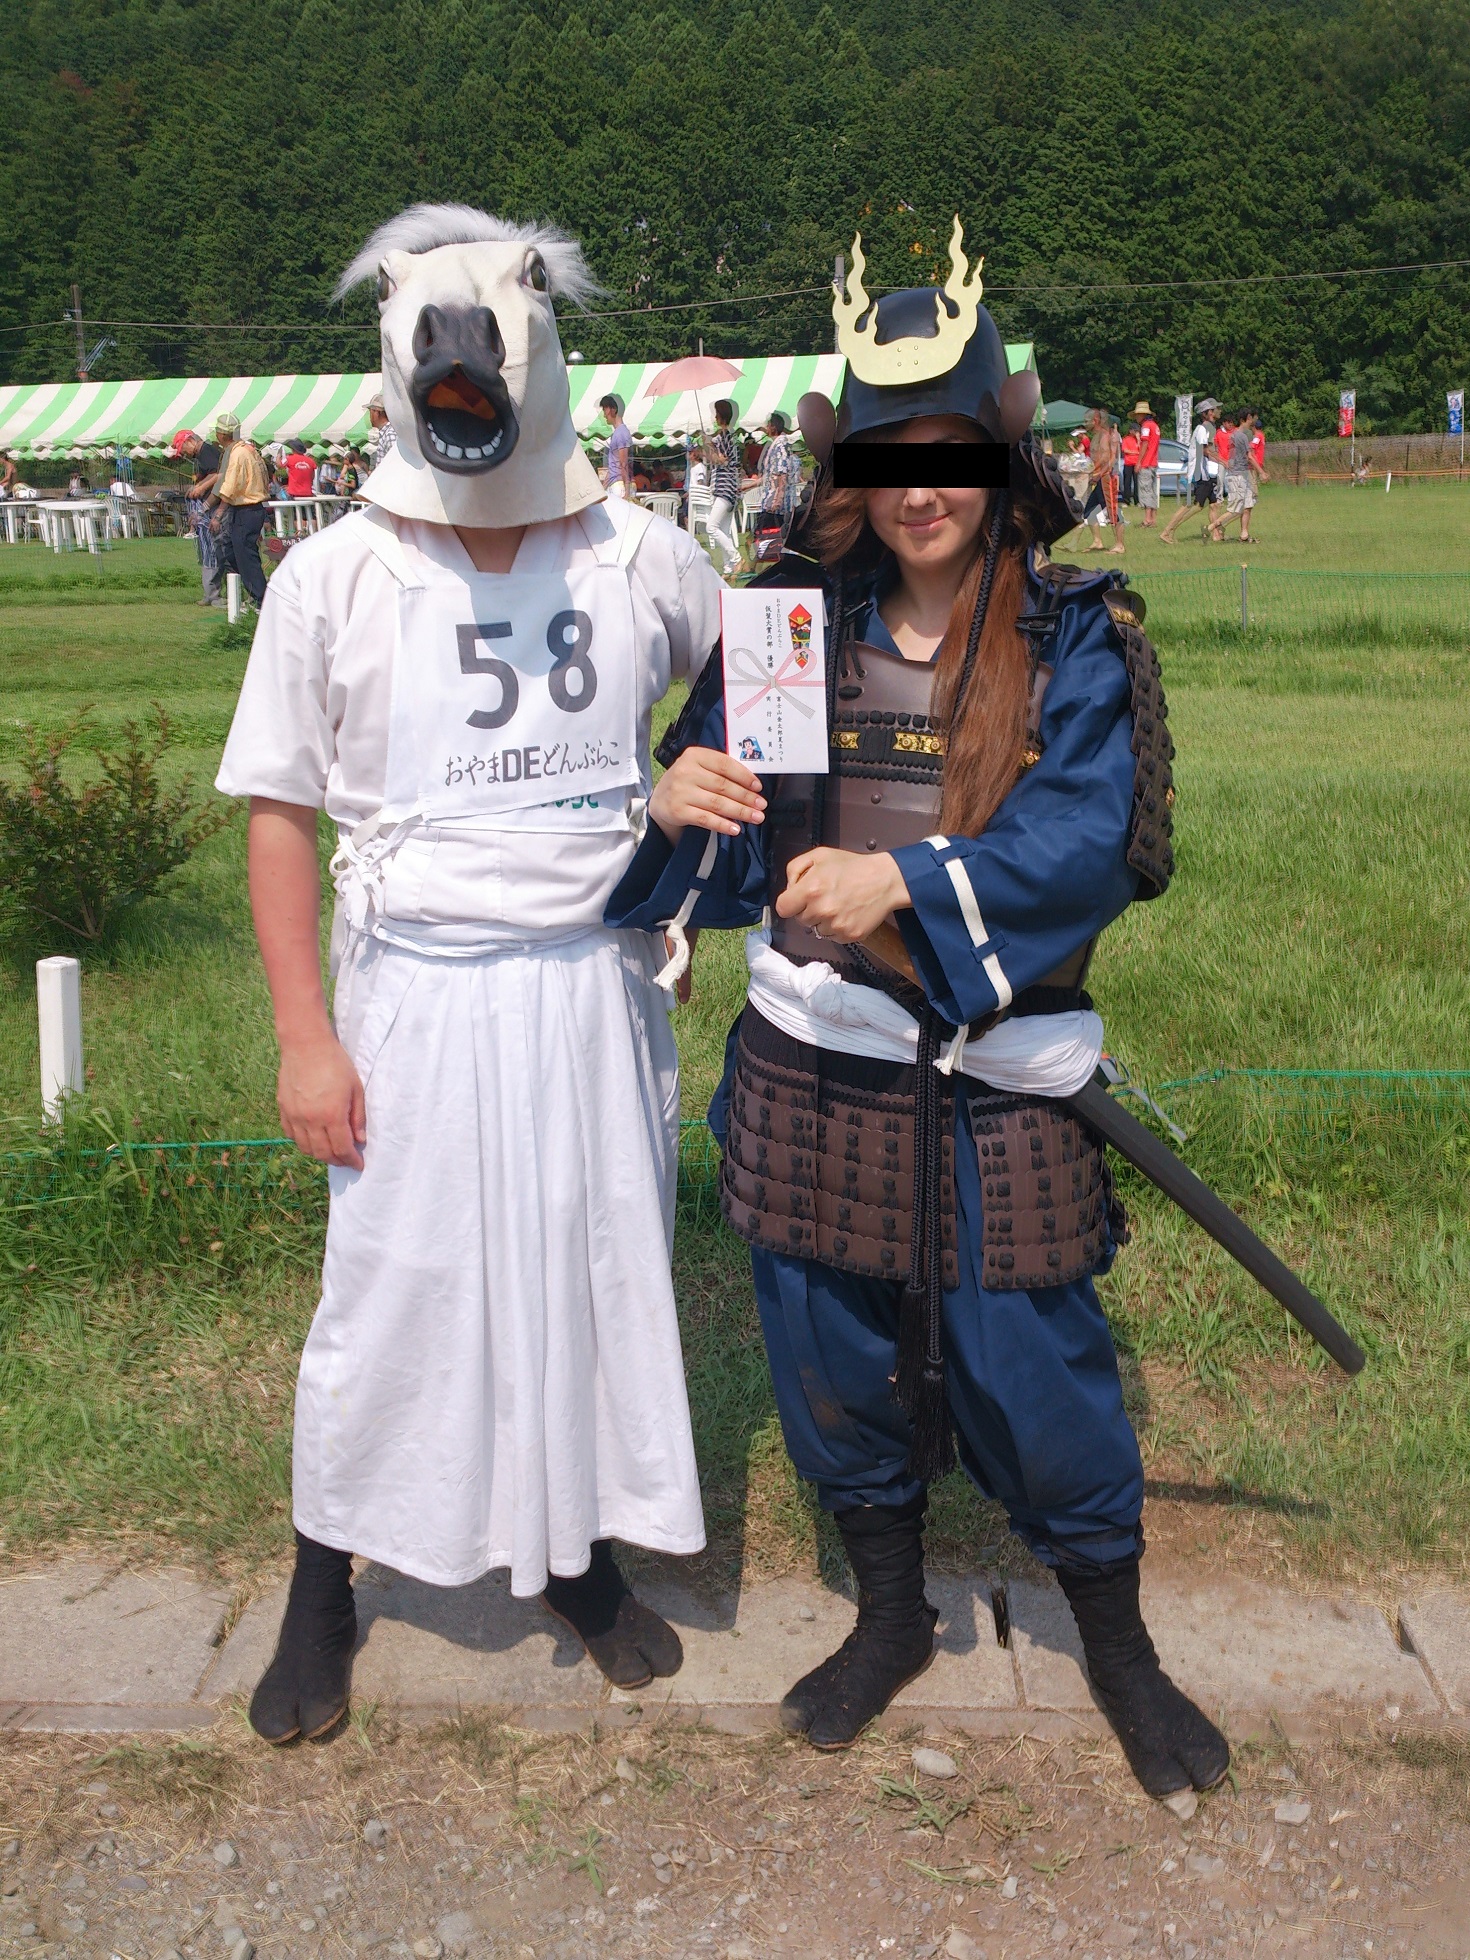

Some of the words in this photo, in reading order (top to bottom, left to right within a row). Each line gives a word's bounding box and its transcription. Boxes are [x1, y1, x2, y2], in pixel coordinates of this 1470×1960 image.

[456, 609, 598, 730] 58
[766, 654, 774, 669] 優勝
[445, 739, 620, 787] おやまDEどんぶらこ
